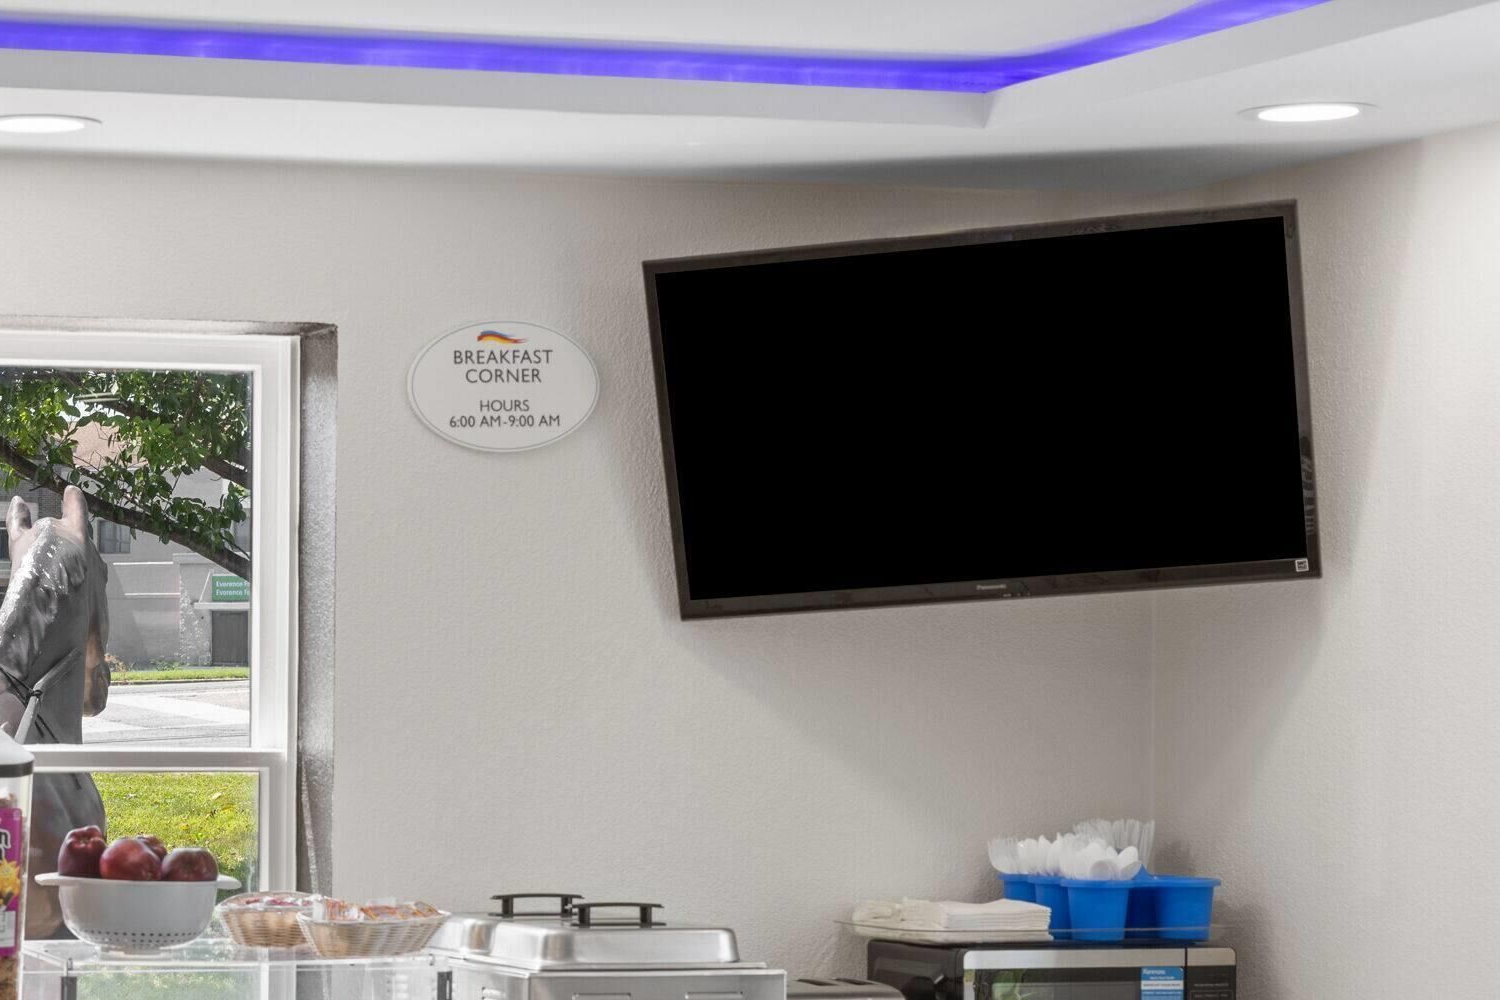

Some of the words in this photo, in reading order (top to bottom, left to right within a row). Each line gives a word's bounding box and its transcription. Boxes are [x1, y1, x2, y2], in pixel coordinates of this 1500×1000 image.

[453, 349, 553, 365] BREAKFAST
[465, 368, 542, 383] CORNER
[479, 399, 530, 412] HOURS
[449, 415, 476, 428] 6:00
[538, 414, 560, 427] AM
